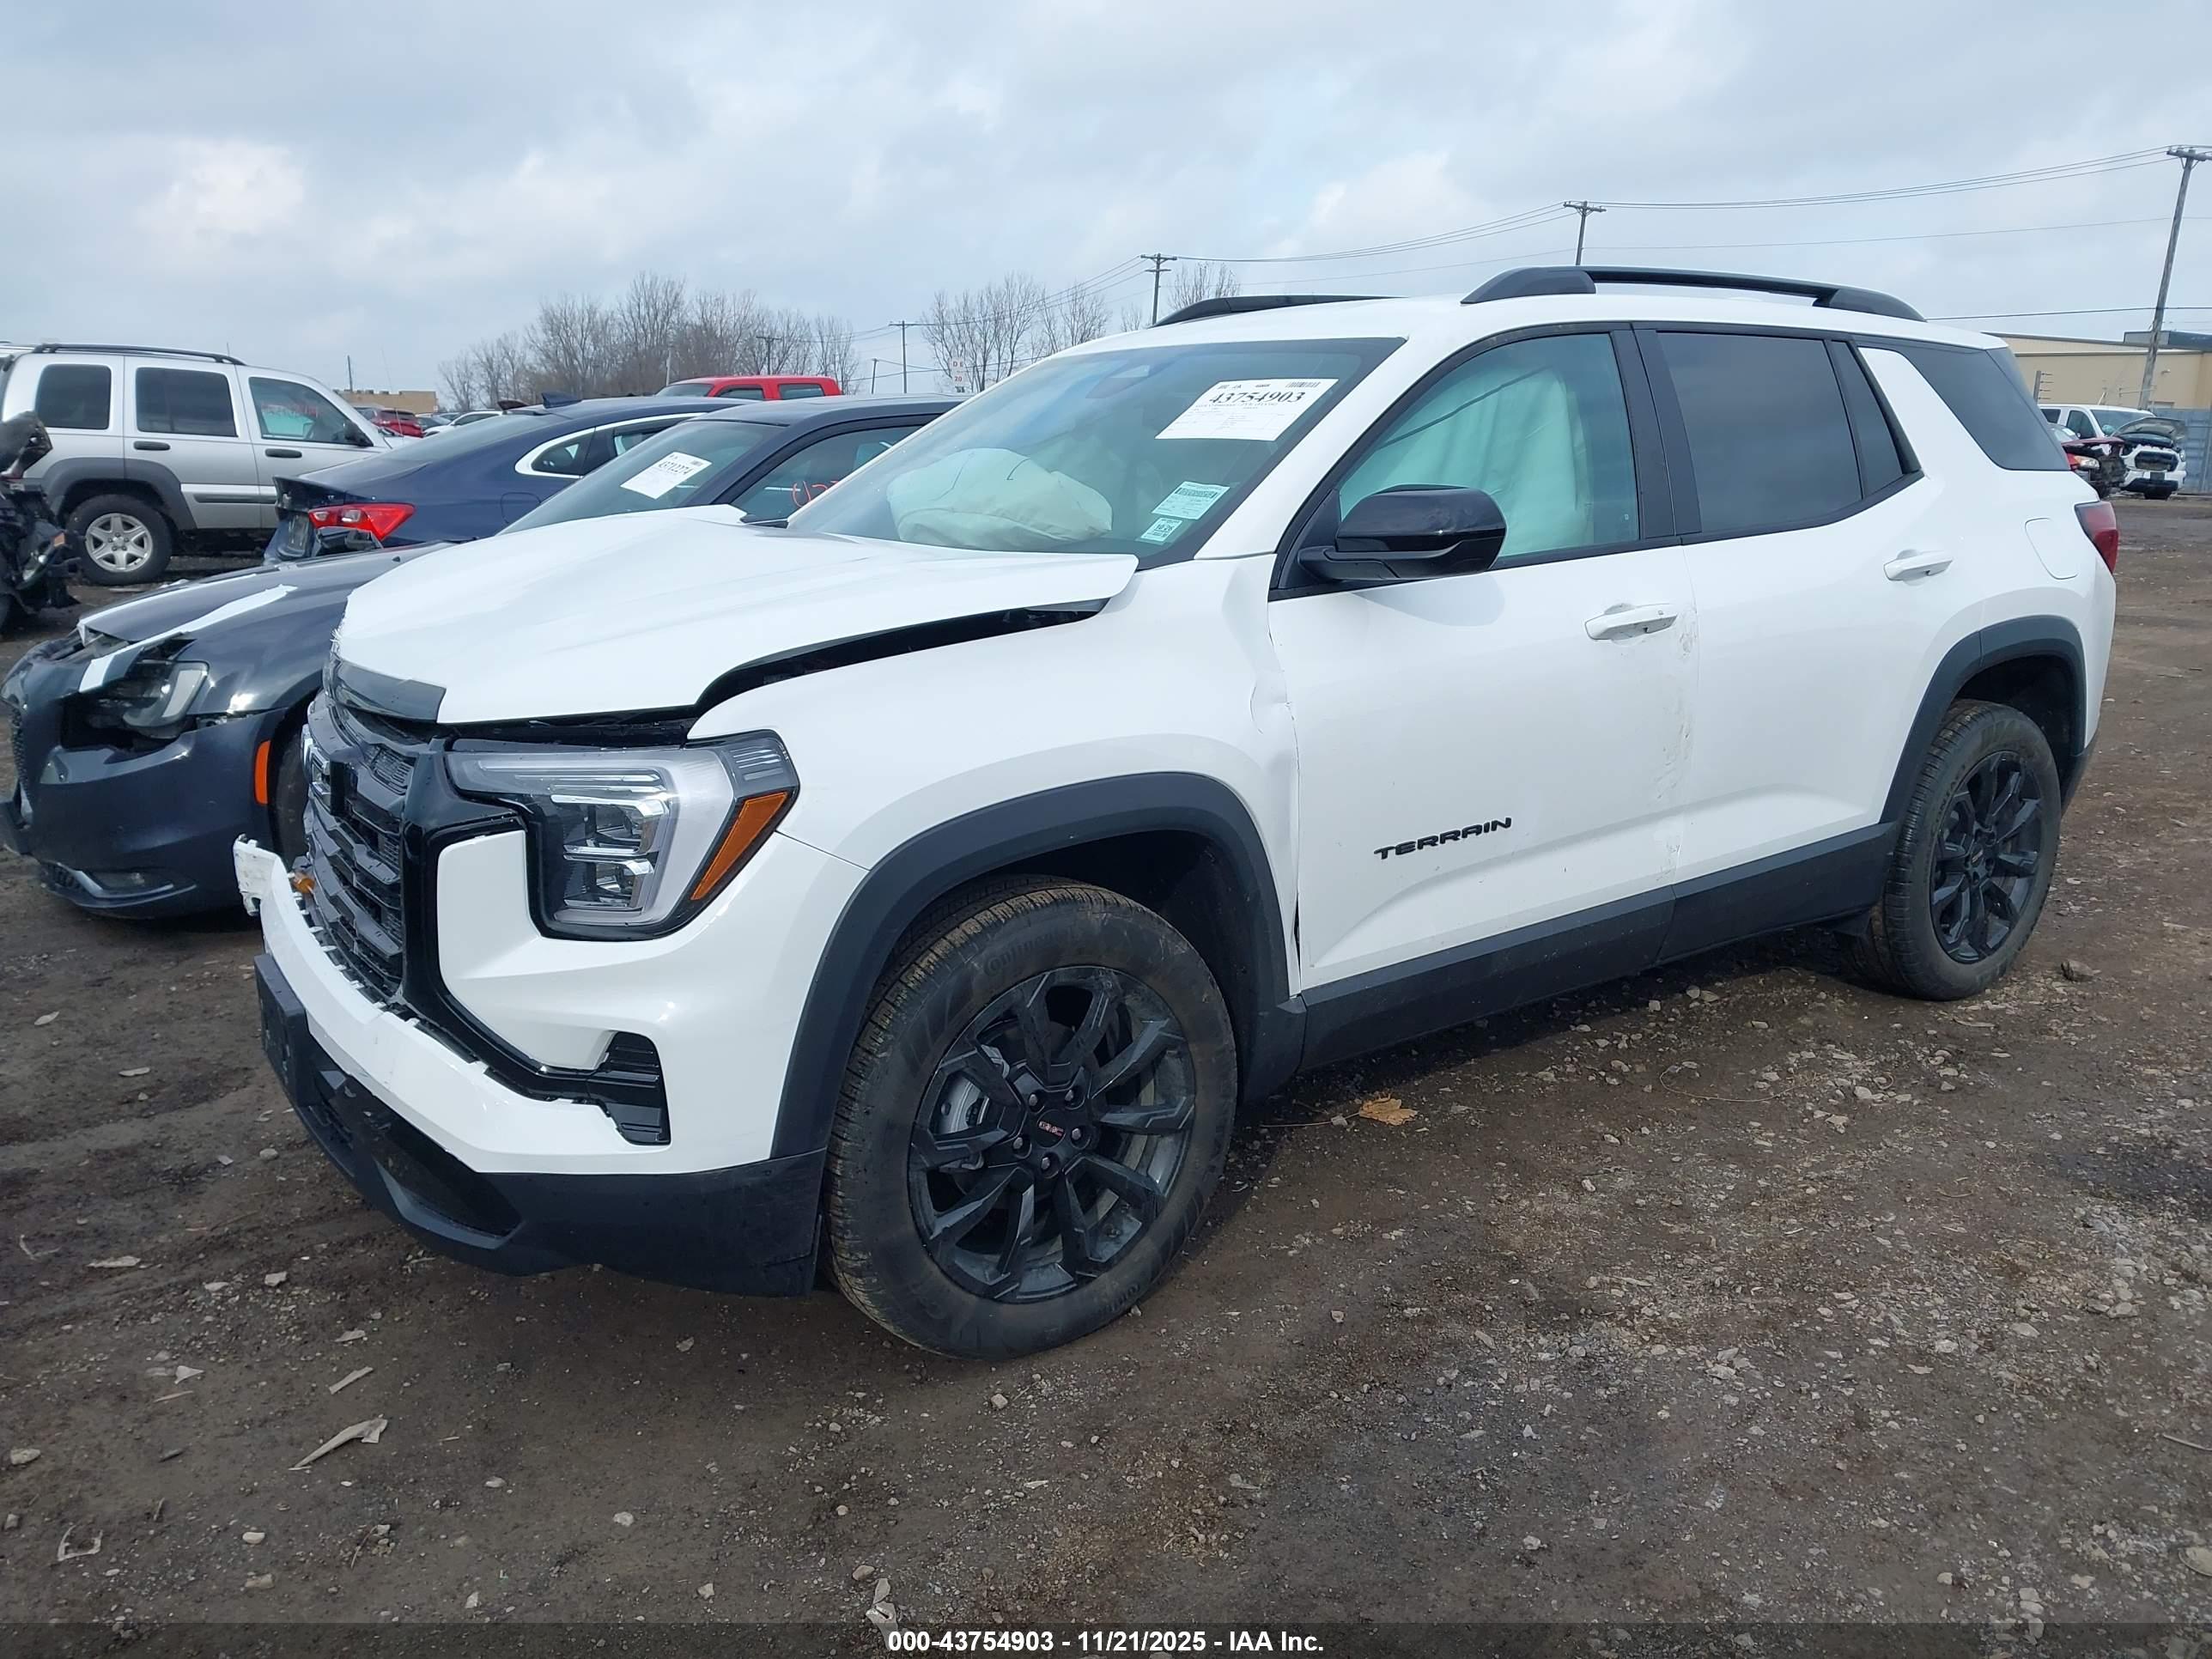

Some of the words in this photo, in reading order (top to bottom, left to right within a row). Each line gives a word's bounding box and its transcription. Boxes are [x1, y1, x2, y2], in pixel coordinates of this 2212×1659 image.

[1209, 390, 1306, 404] 43754903
[1374, 817, 1512, 860] TERRAIN
[1039, 1121, 1064, 1137] GMC
